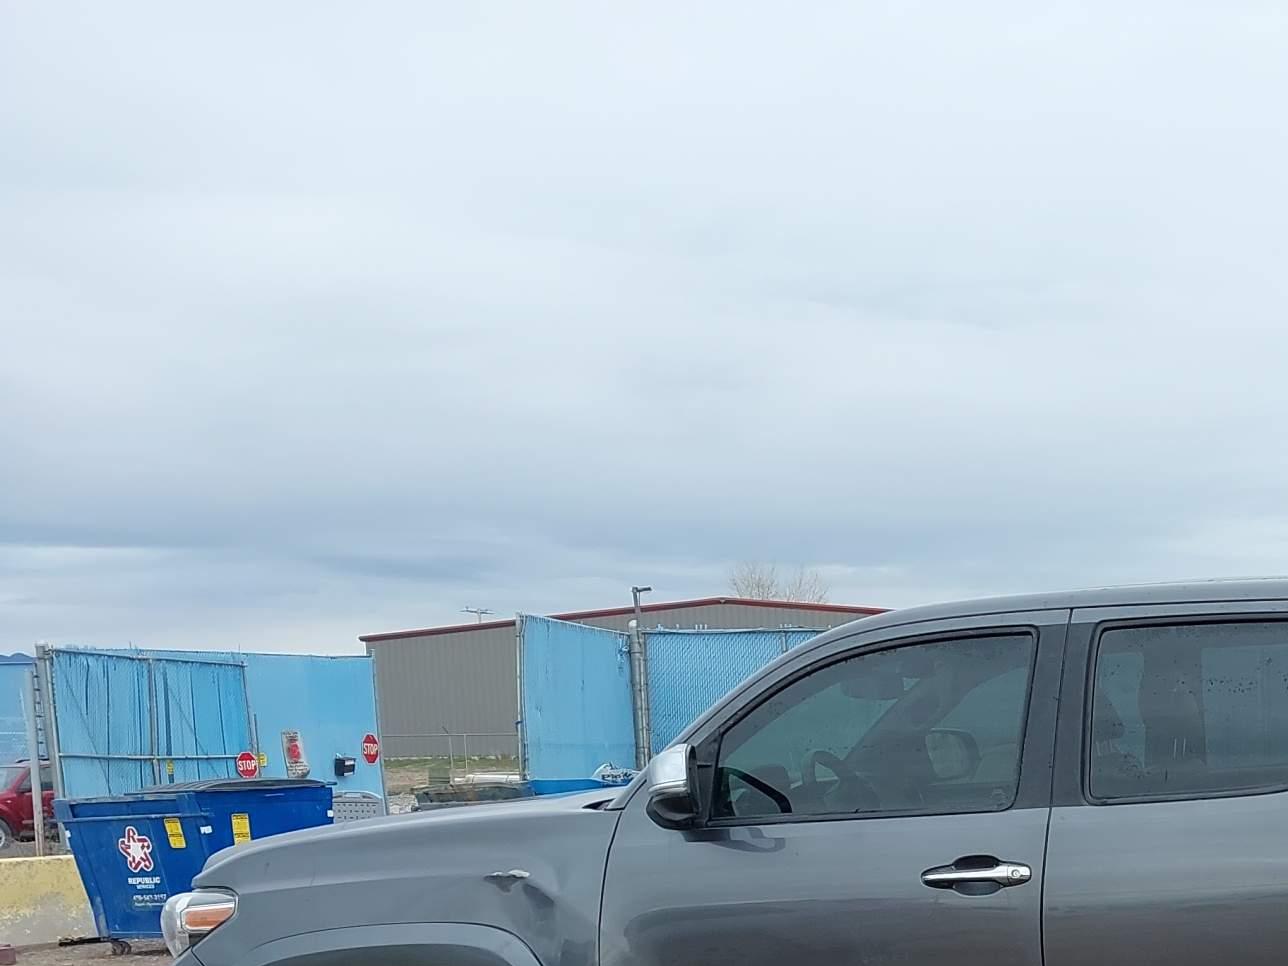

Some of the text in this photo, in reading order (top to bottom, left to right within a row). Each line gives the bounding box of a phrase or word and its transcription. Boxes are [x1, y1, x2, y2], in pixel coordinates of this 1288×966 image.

[363, 743, 378, 755] STOP
[238, 760, 257, 771] STOP
[127, 876, 161, 885] REPUBLIC
